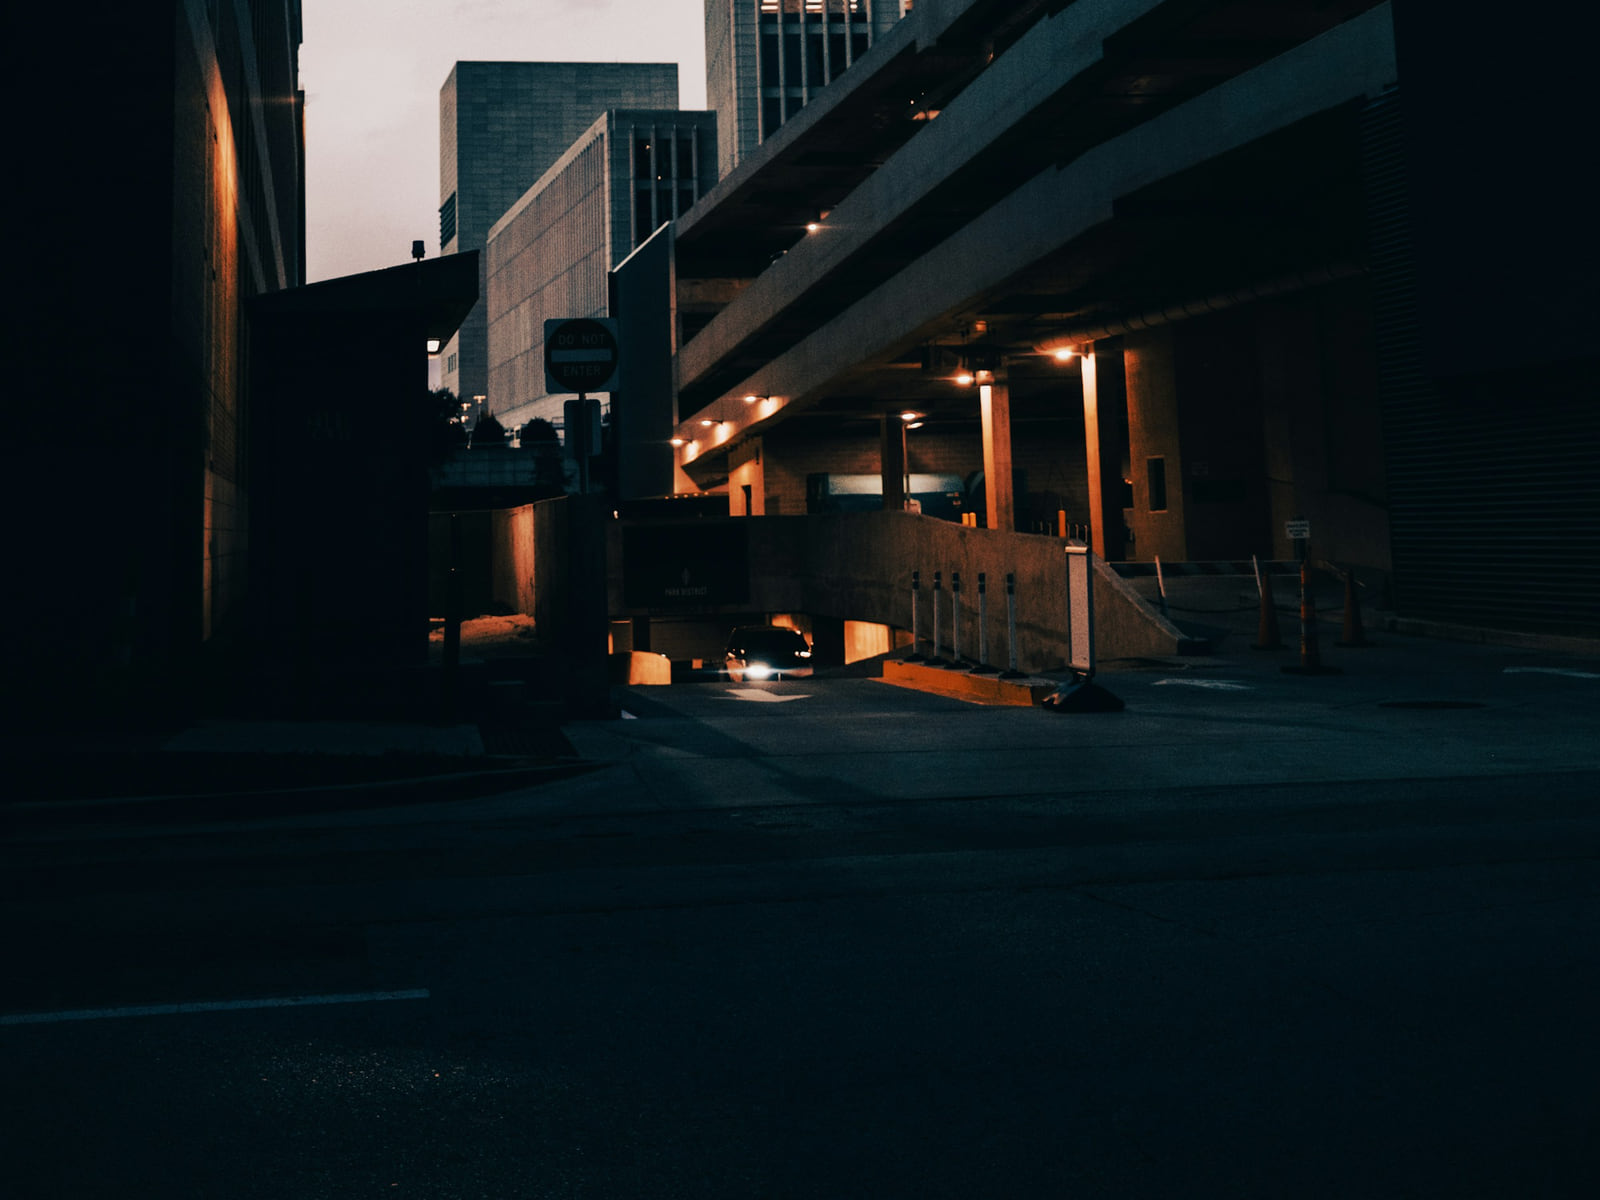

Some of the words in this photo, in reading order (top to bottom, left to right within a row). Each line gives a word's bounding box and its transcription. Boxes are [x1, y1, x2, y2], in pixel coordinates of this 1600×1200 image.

[558, 334, 575, 345] DO
[582, 334, 605, 345] NOT
[563, 365, 601, 377] ENTER
